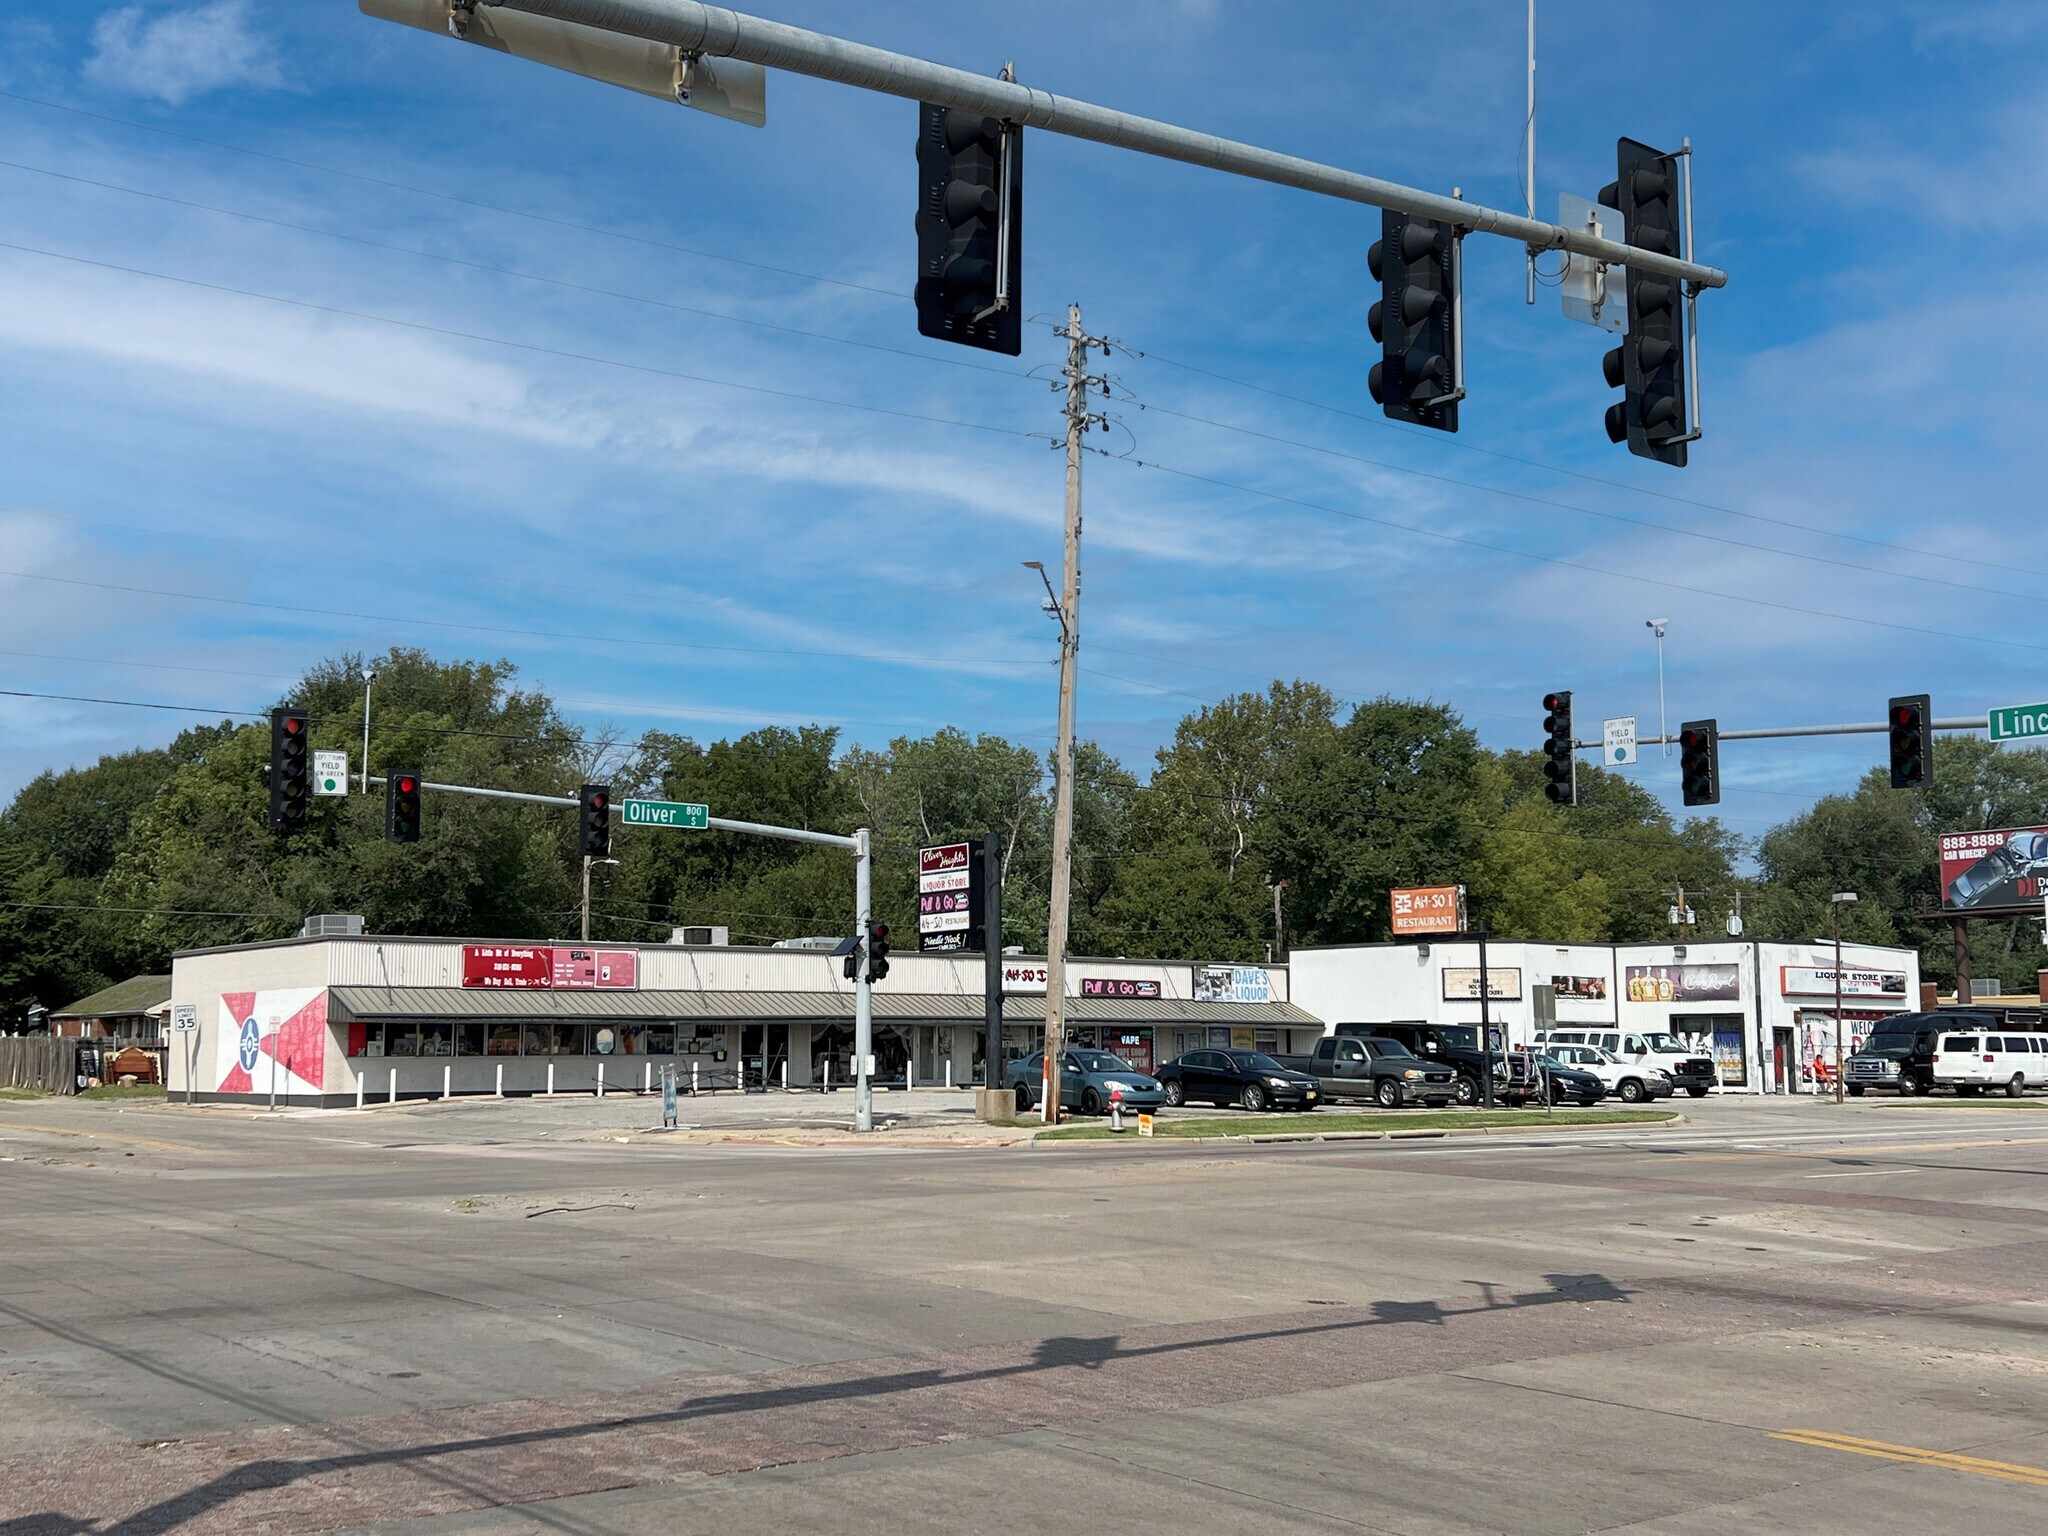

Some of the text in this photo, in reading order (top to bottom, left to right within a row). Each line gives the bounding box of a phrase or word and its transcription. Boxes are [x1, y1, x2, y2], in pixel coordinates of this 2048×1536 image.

[1611, 729, 1628, 737] YIELD
[630, 803, 701, 823] Oliver 800
[691, 817, 696, 826] S
[1943, 834, 2004, 849] 888-8888
[923, 850, 943, 863] Oliver
[940, 851, 965, 868] Heights
[1943, 848, 1987, 860] CAR WRECK?
[923, 878, 966, 891] LIQUOR STORE
[921, 897, 933, 911] Puff
[935, 896, 941, 911] &
[944, 895, 953, 910] Go
[1414, 894, 1445, 909] AH-SO
[1397, 916, 1452, 928] RESTAURANT
[924, 933, 961, 946] Needle Nook
[1005, 969, 1034, 982] AH-SO
[1235, 971, 1268, 985] DAVE'S
[1085, 981, 1103, 993] Puff
[1108, 982, 1115, 994] &
[1120, 982, 1134, 994] Go
[1236, 987, 1268, 1001] LIQUOR
[178, 1018, 195, 1029] 35
[1121, 1035, 1140, 1045] VAPE
[1115, 1048, 1146, 1057] VAPE SHOP
